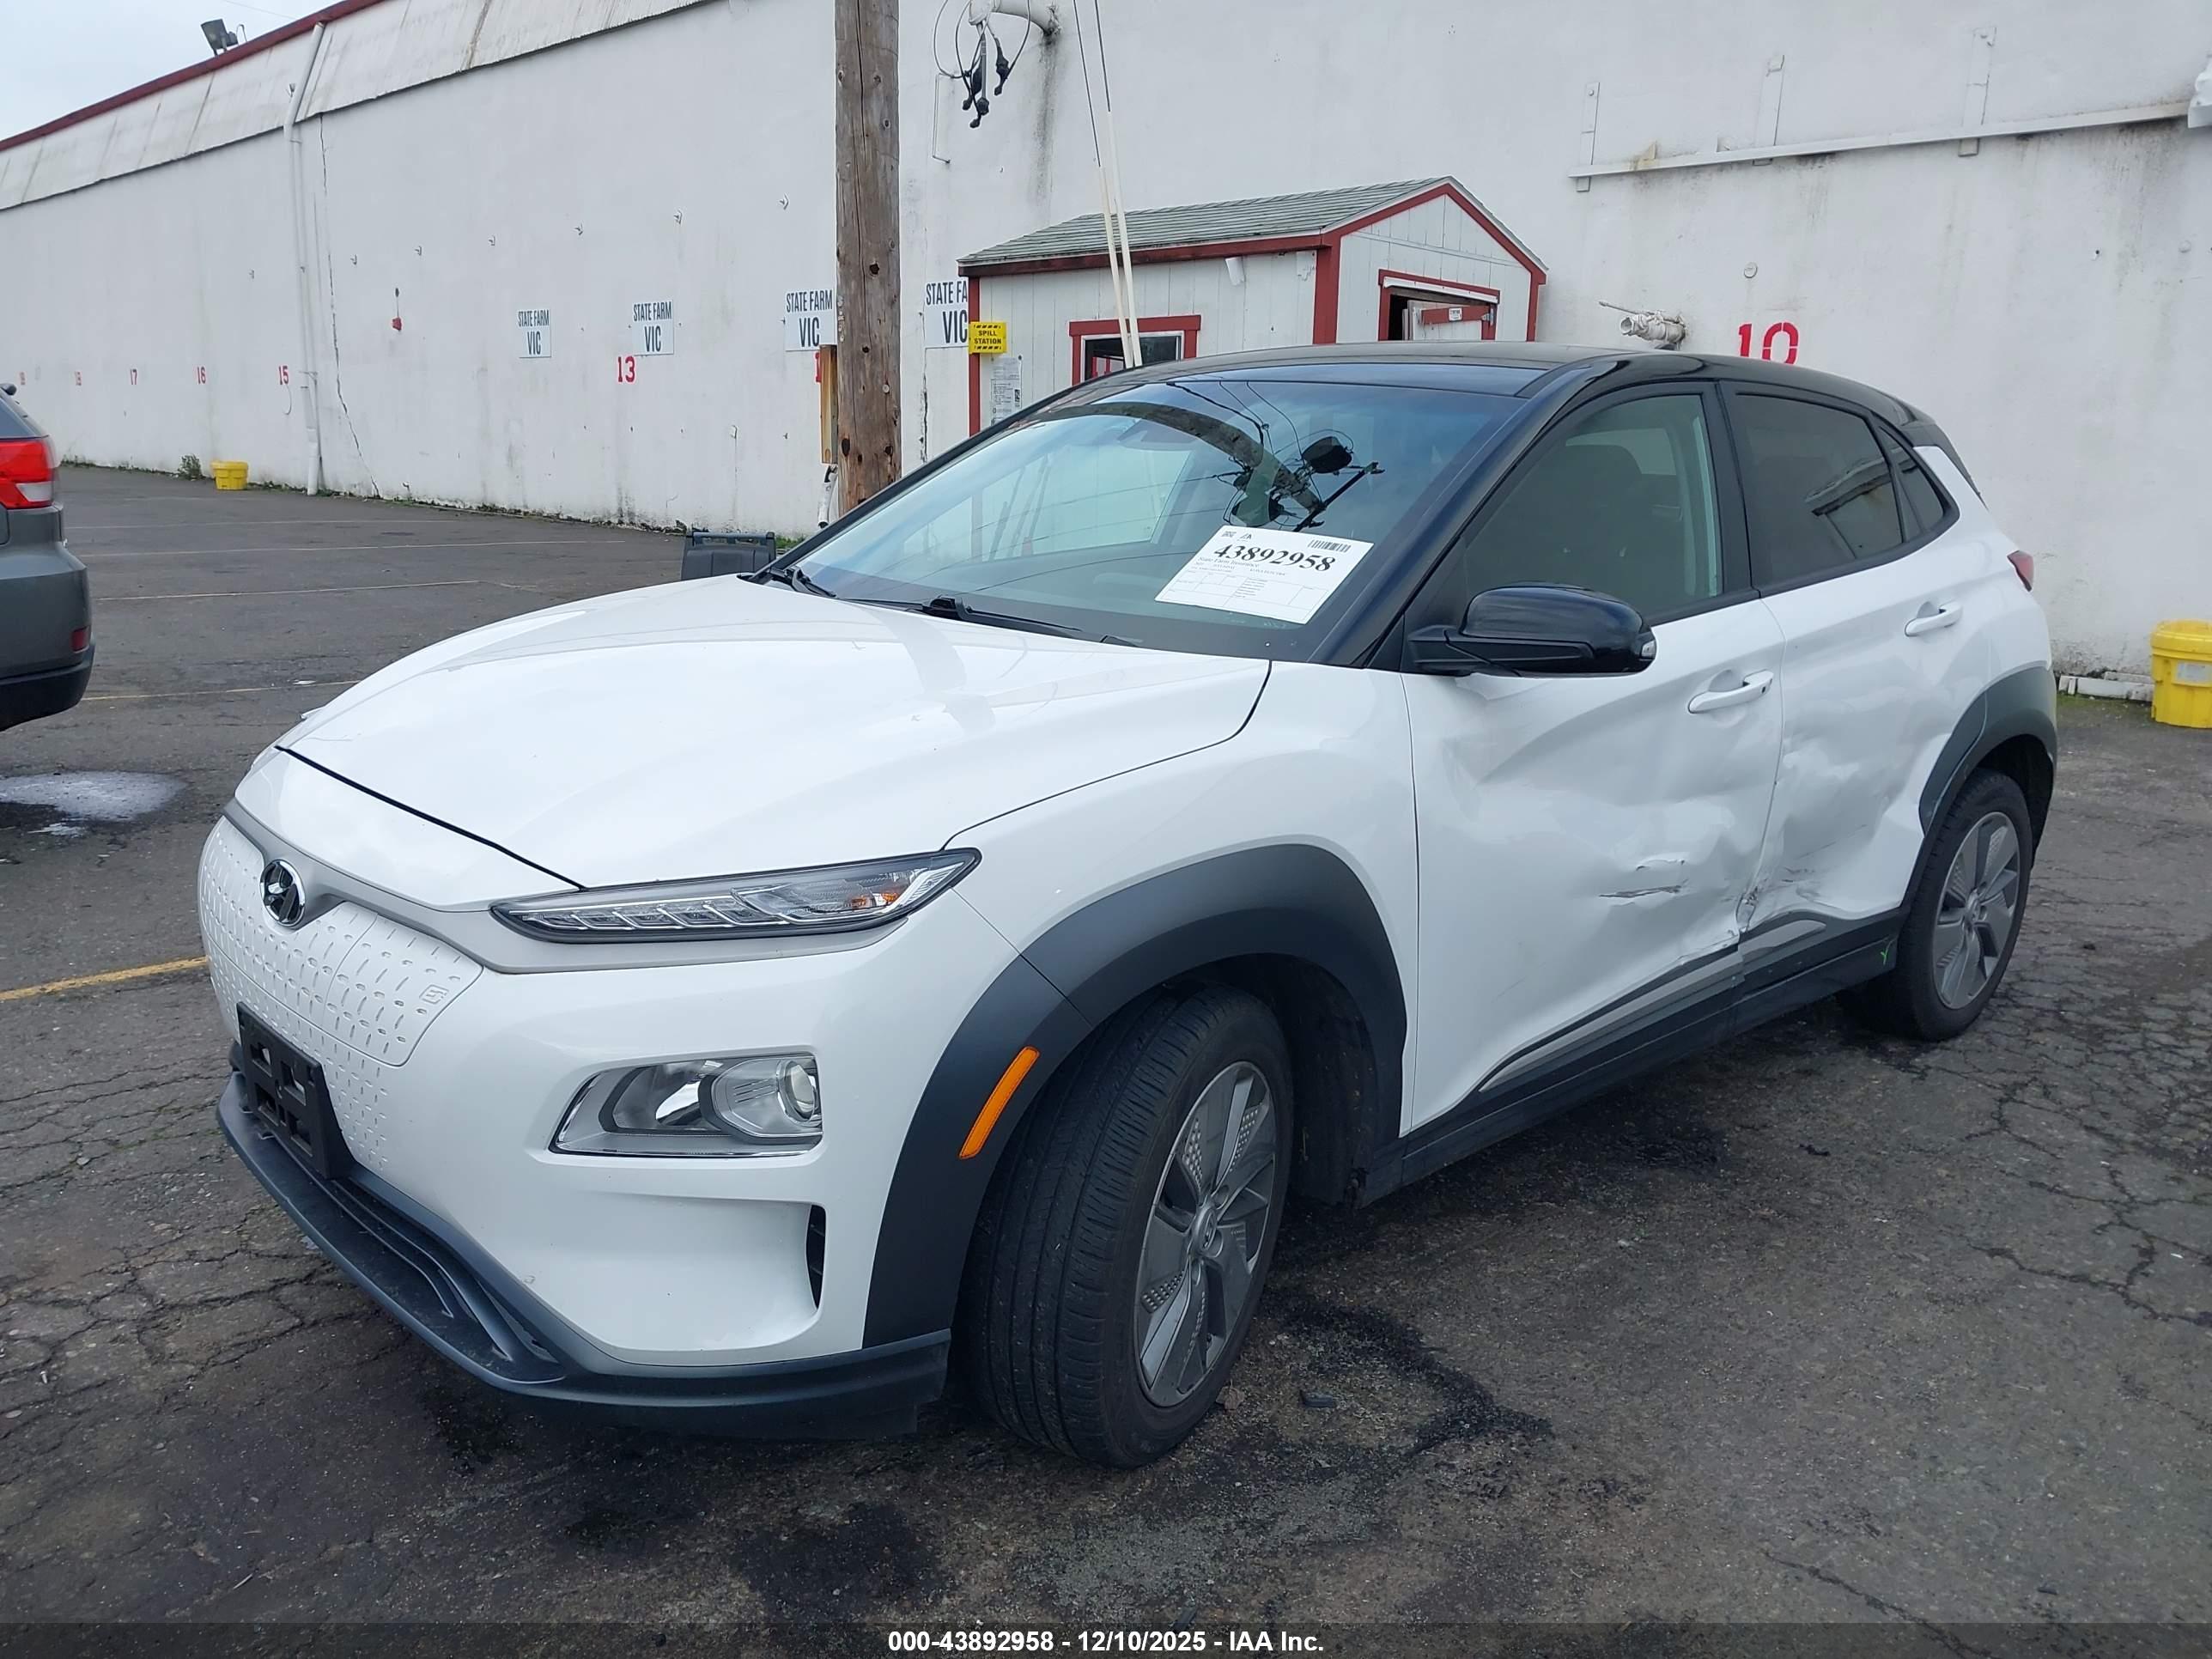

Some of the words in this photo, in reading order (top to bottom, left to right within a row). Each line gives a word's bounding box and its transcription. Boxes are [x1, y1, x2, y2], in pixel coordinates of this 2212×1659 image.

[787, 292, 808, 313] STATE
[810, 289, 833, 311] FARM
[926, 282, 953, 305] STATE
[957, 281, 968, 303] FA
[518, 310, 532, 327] STATE
[533, 309, 550, 326] FARM
[634, 303, 652, 322] STATE
[653, 301, 672, 320] FARM
[799, 316, 820, 348] VIC
[942, 309, 968, 344] VIC
[526, 331, 541, 355] VIC
[644, 325, 661, 353] VIC
[1738, 322, 1799, 365] 10
[130, 368, 138, 386] 17
[278, 365, 289, 386] 15
[617, 356, 635, 383] 13
[1213, 544, 1336, 572] 43892958
